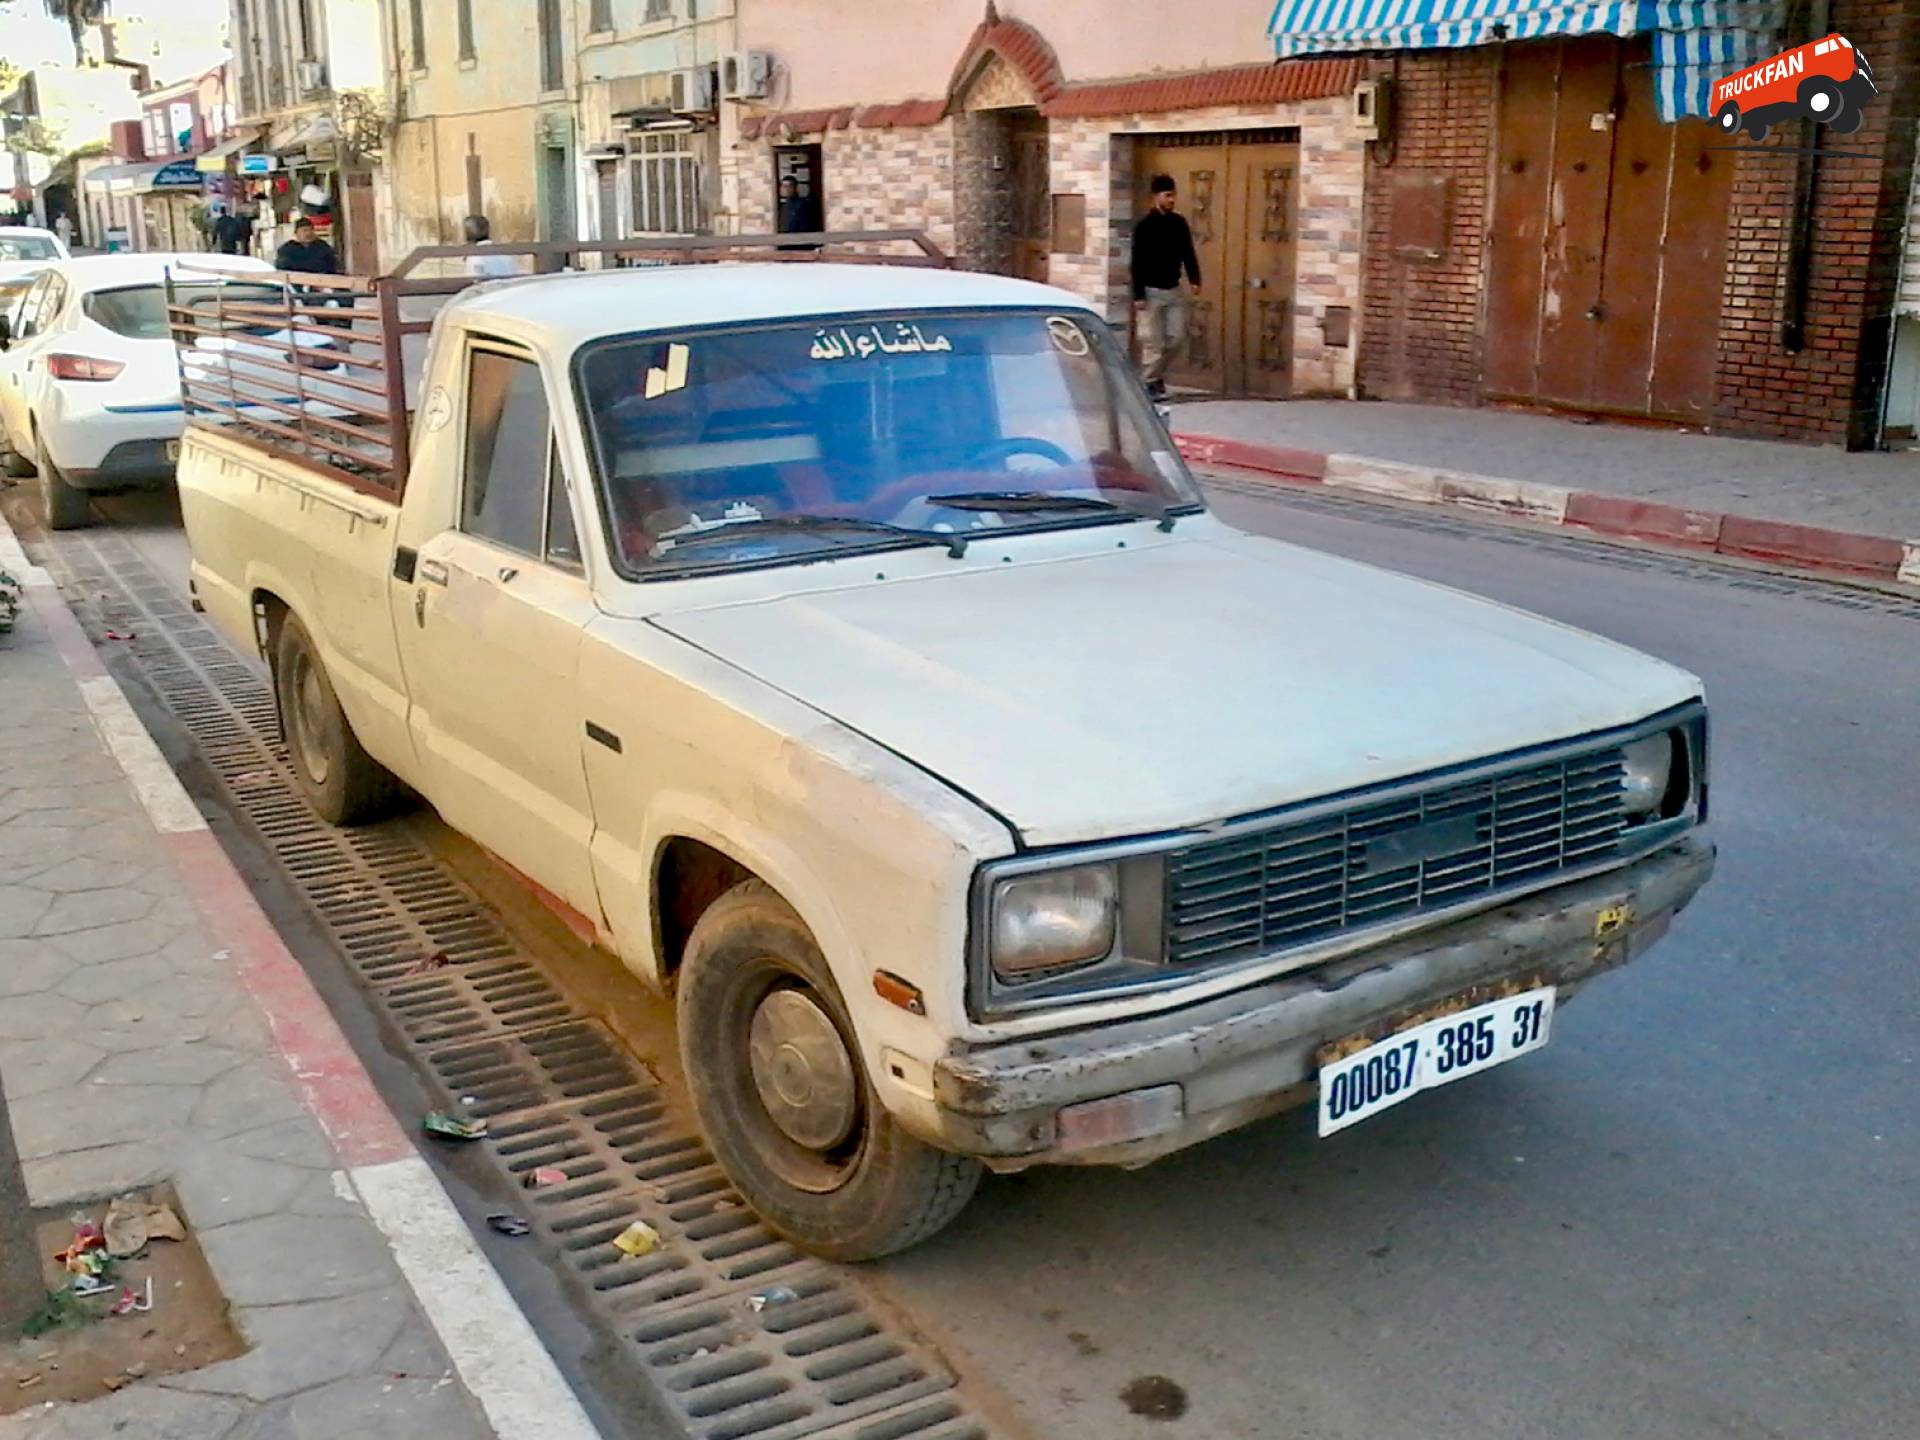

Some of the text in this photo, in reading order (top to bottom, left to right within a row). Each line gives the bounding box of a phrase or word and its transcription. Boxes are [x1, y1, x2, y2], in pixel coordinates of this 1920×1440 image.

[1329, 1000, 1543, 1119] 00087 385 31
